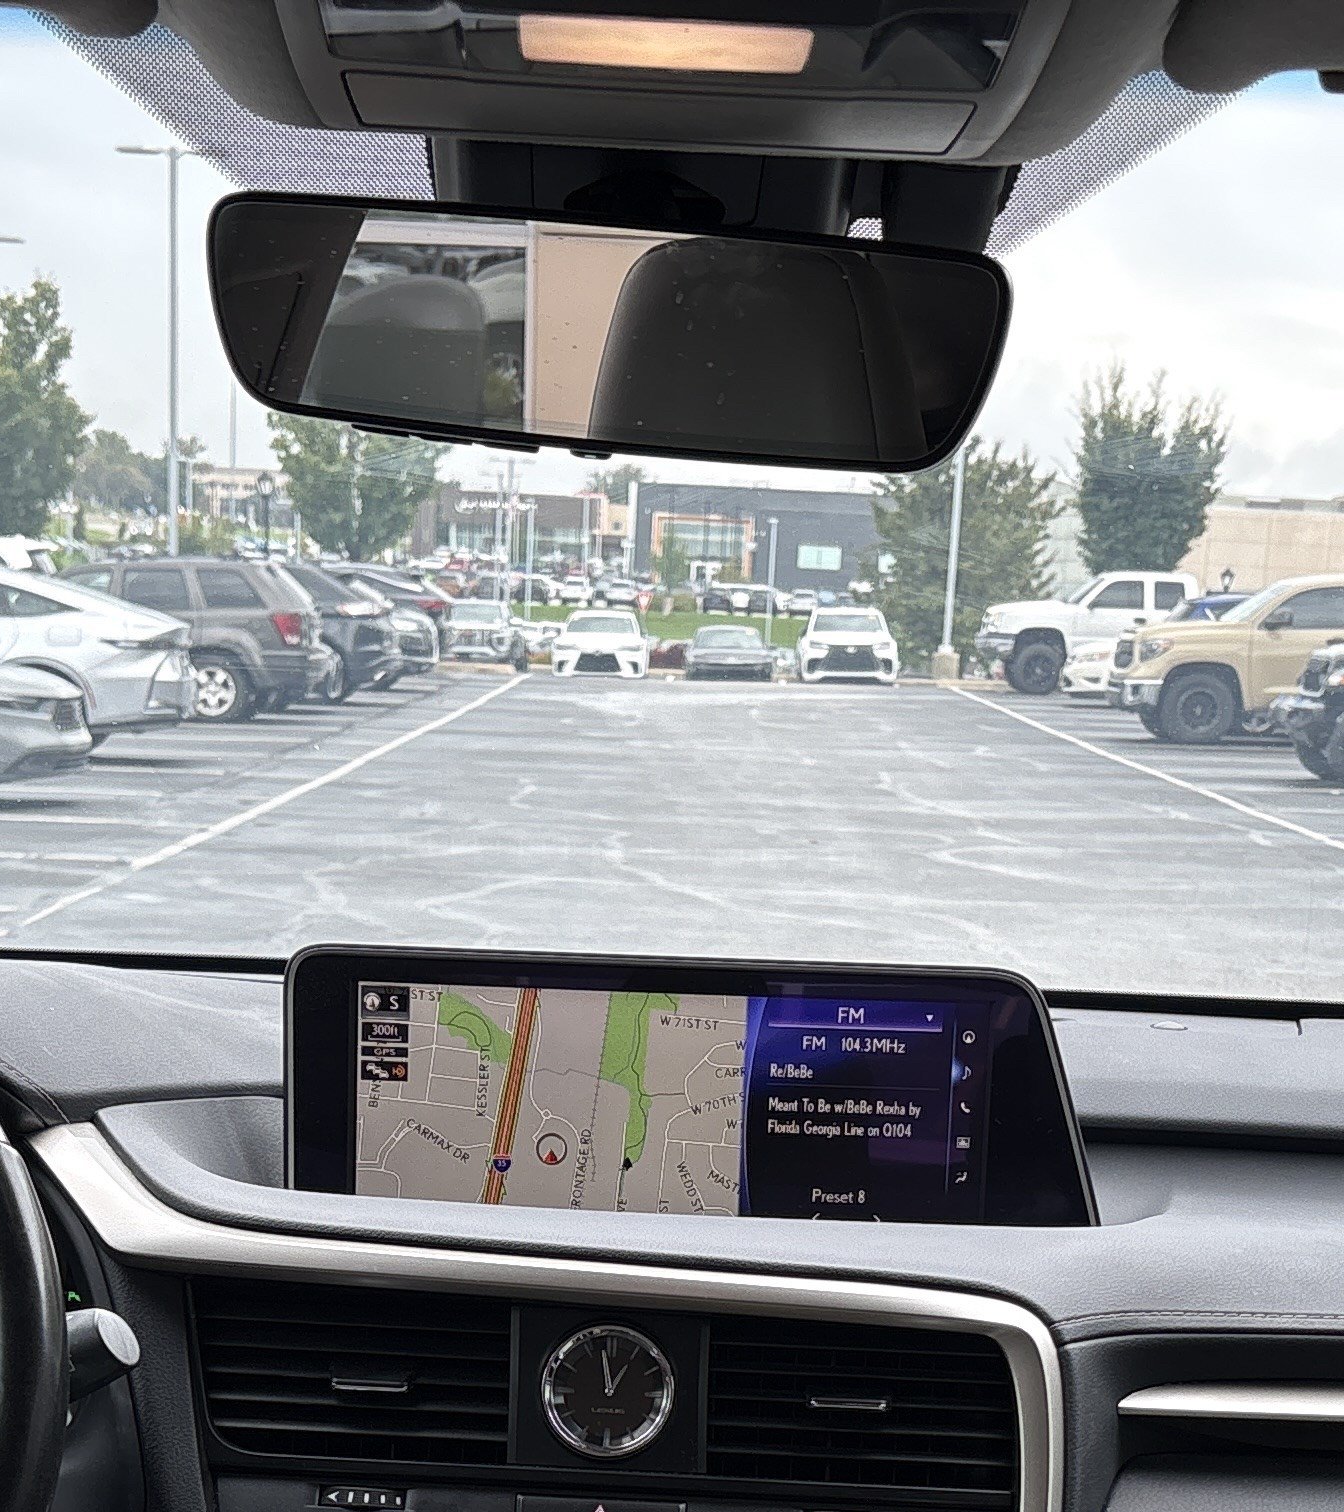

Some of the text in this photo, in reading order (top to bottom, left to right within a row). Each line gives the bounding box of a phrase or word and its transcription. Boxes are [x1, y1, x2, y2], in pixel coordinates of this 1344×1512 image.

[390, 997, 400, 1011] S
[660, 1015, 719, 1031] W 71ST ST
[837, 1007, 864, 1024] FM
[372, 1024, 400, 1037] 300ft
[374, 1048, 397, 1058] GPS
[803, 1036, 906, 1055] FM 104.3MHz
[769, 1063, 814, 1079] Re/BeBe
[478, 1046, 494, 1119] KESSLER ST
[692, 1106, 702, 1117] W
[703, 1095, 737, 1113] 70TH
[768, 1097, 922, 1119] Meant To Be w/BeBe Rexha by
[726, 1119, 739, 1130] W
[767, 1120, 912, 1139] Florida Georgia Line on Q104
[406, 1118, 473, 1166] CARMAX DR
[581, 1128, 592, 1147] RD
[676, 1161, 705, 1213] WEDD ST
[811, 1188, 866, 1205] Preset 8
